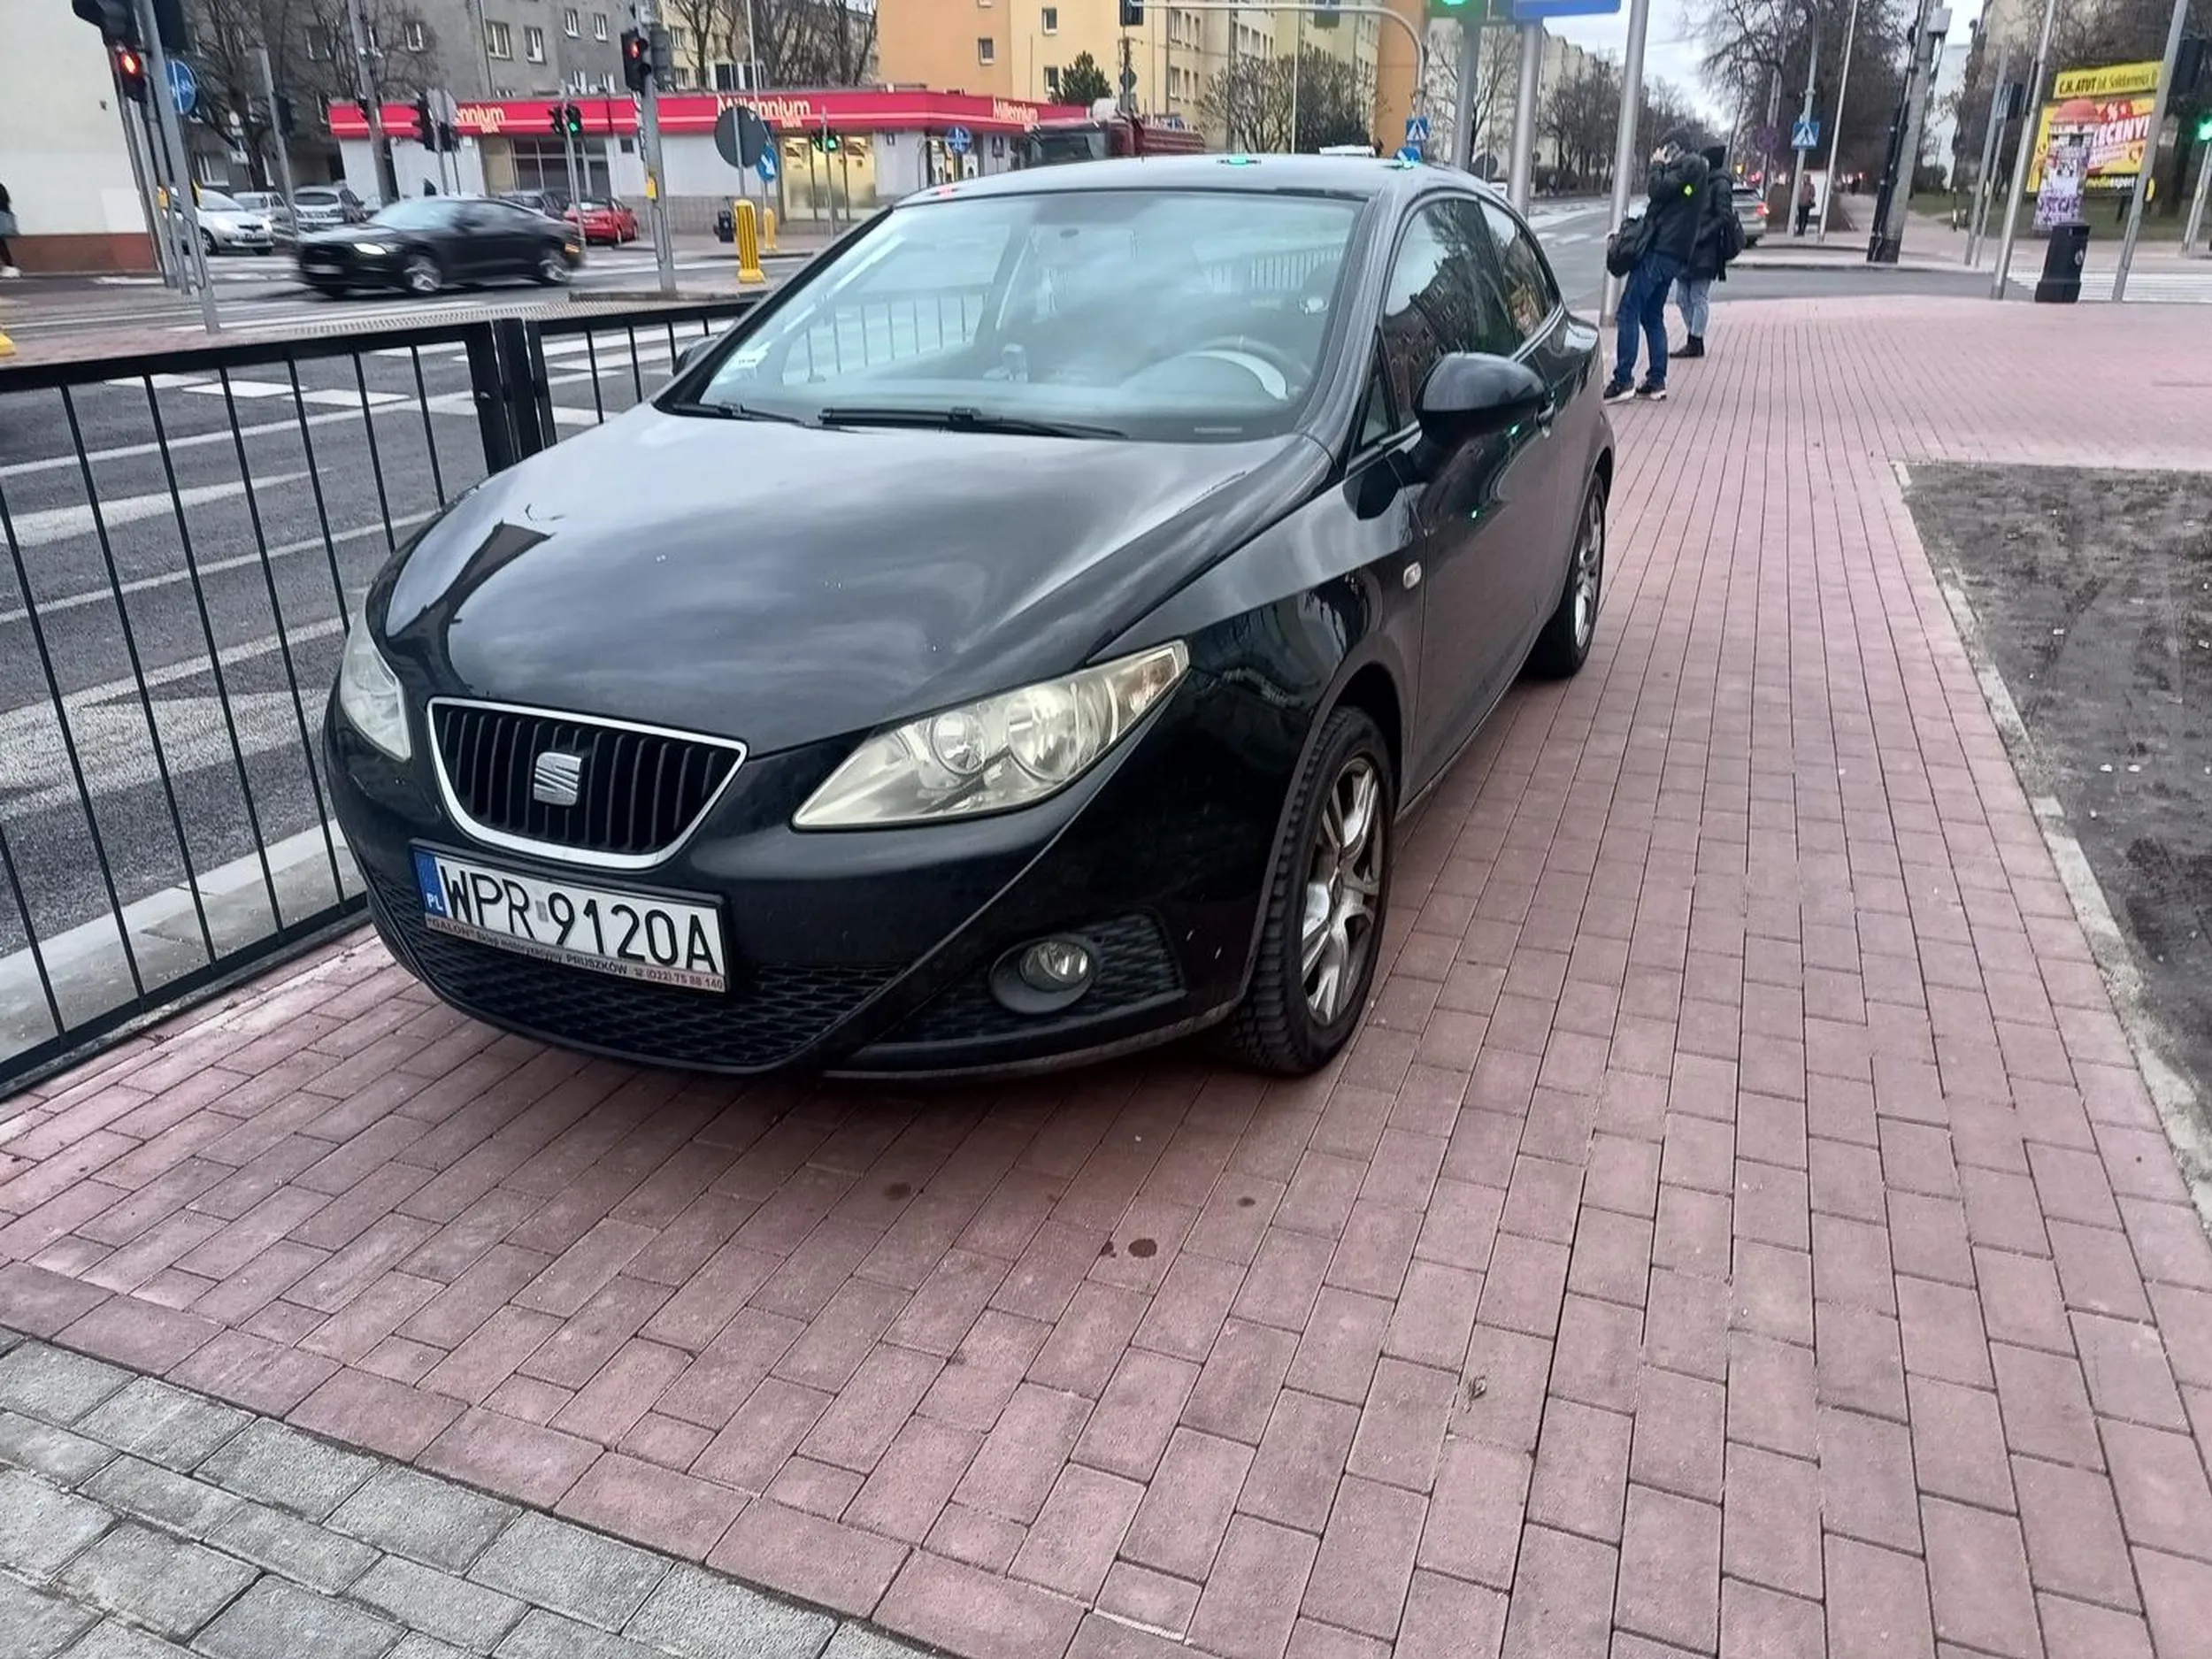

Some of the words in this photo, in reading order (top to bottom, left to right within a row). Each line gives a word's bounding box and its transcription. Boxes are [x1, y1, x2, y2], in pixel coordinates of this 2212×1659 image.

[426, 893, 443, 911] PL
[440, 865, 534, 940] WPR
[548, 892, 718, 973] 9120A
[566, 953, 627, 974] PRUSZKÓW
